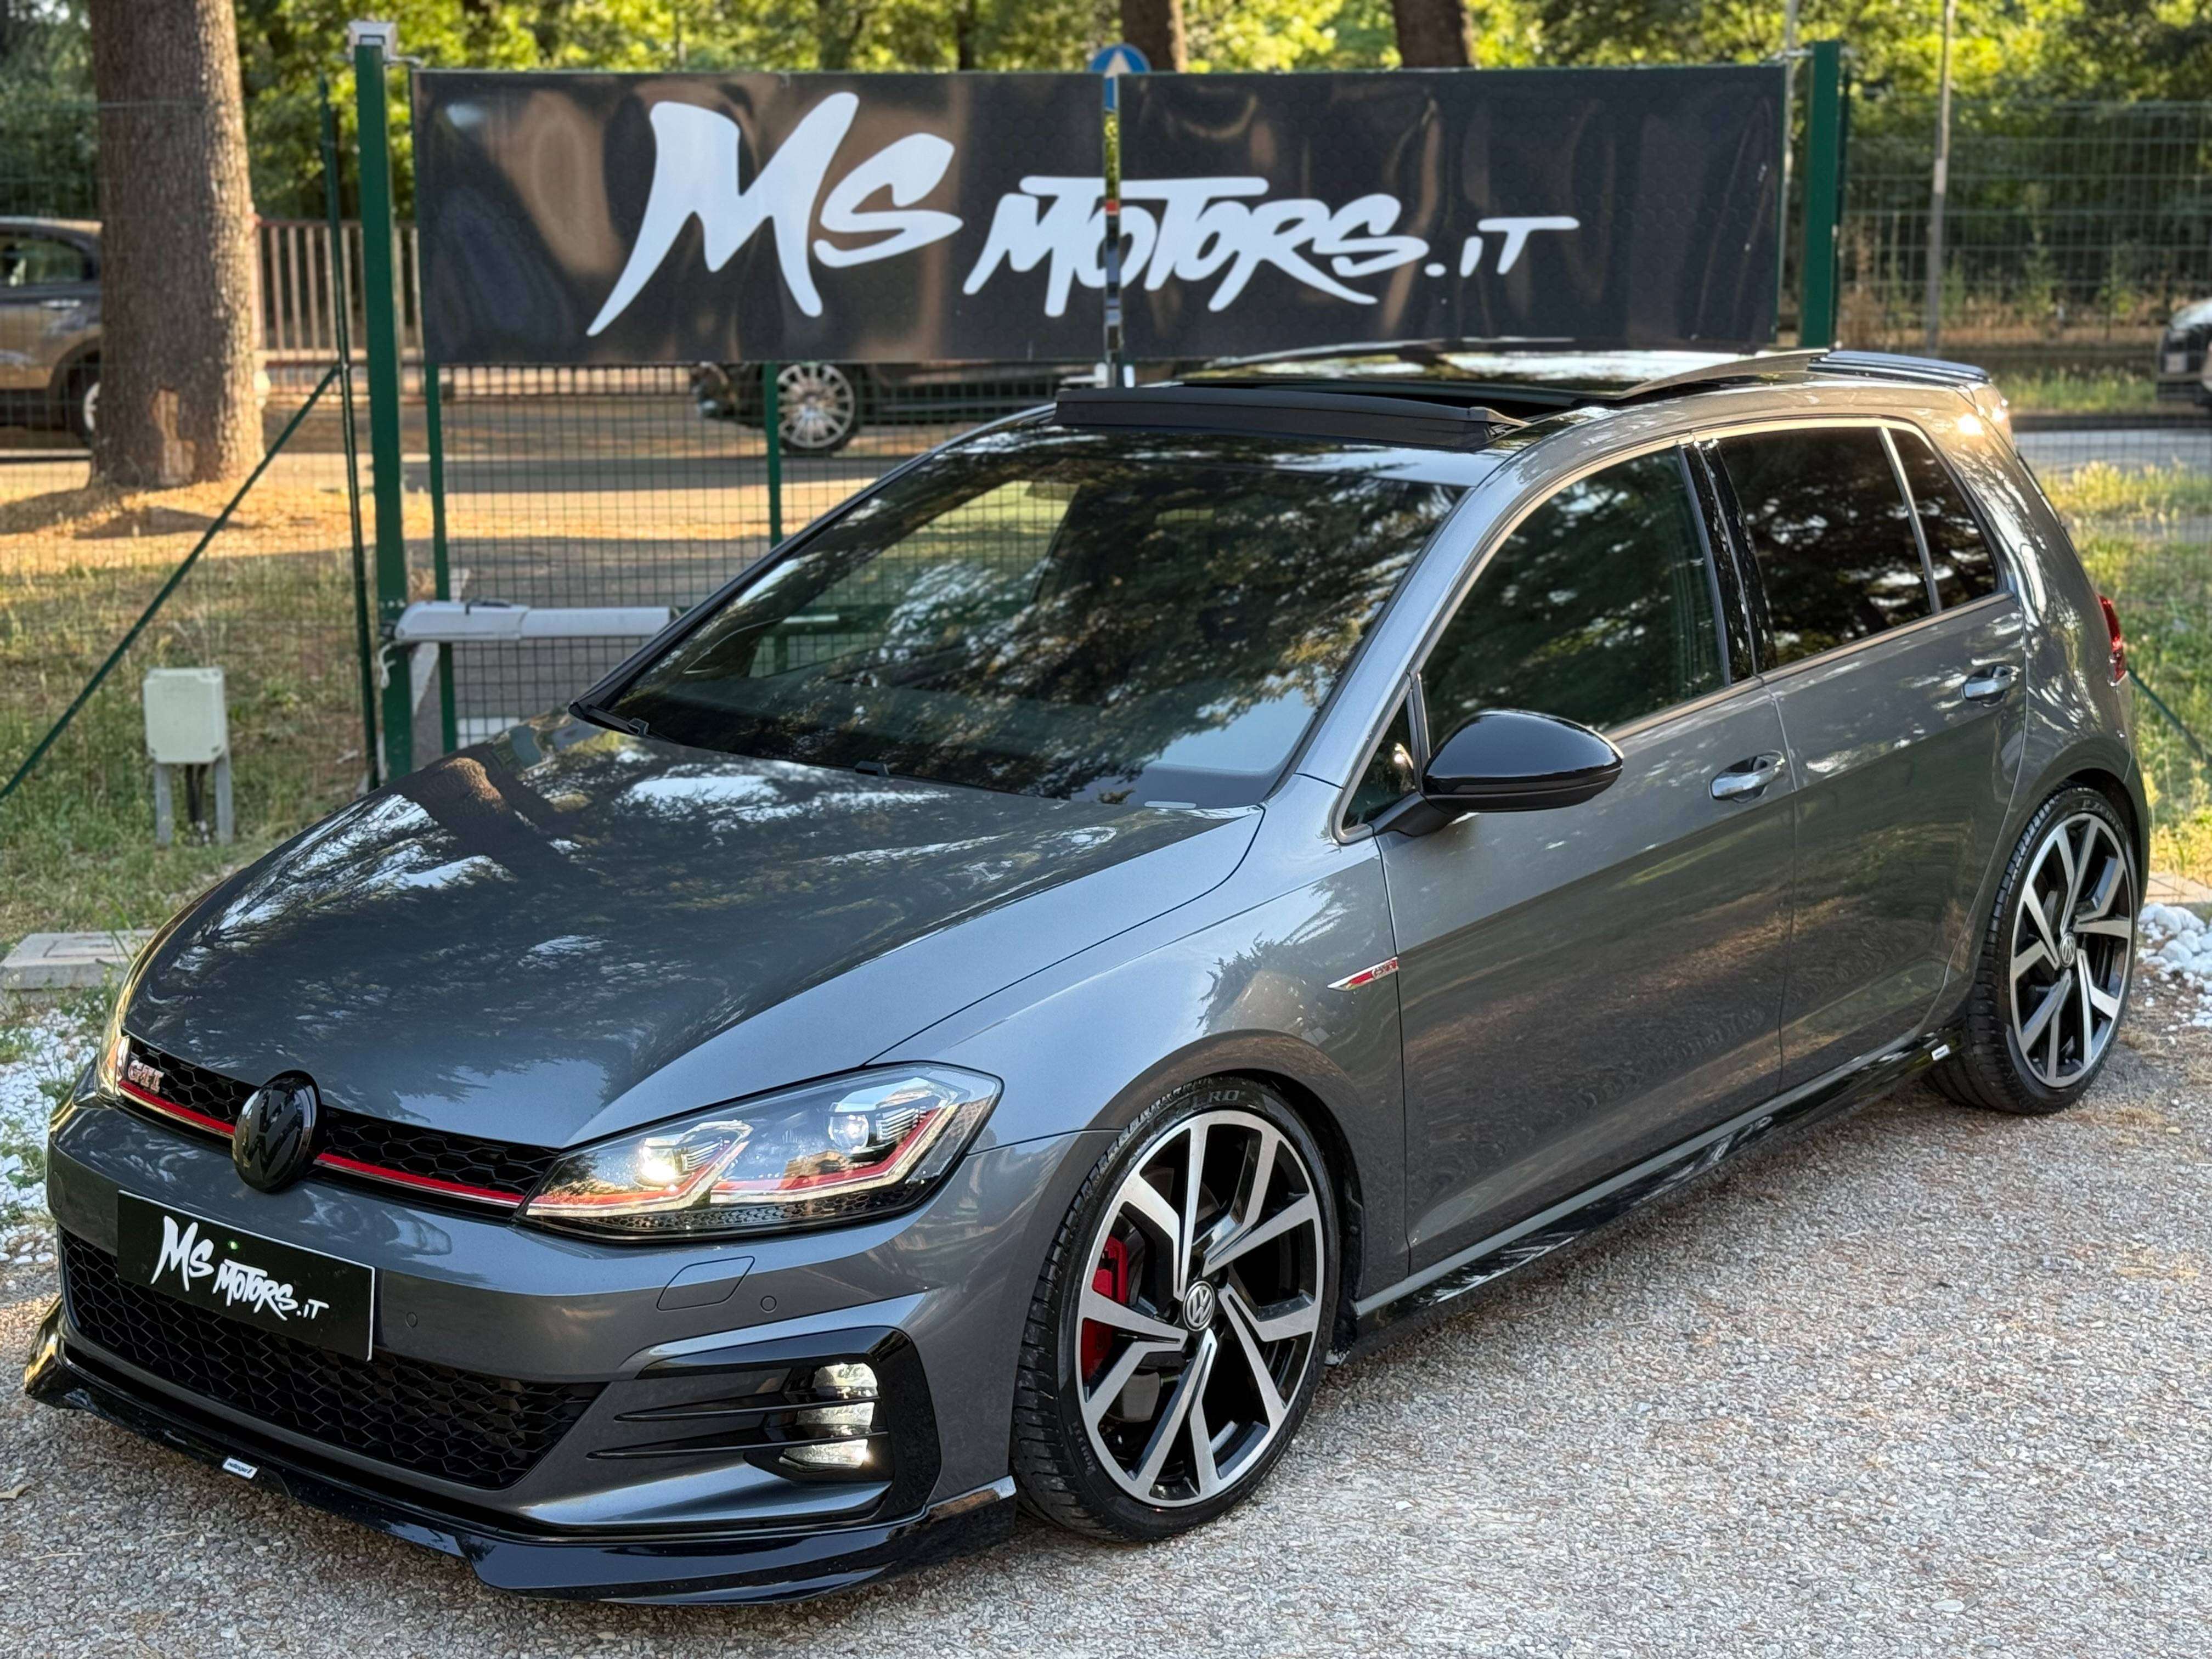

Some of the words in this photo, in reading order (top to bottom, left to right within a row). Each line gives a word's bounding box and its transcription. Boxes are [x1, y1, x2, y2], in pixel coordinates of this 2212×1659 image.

[587, 91, 963, 335] MS
[128, 1059, 165, 1093] GTI
[151, 1215, 215, 1292] MS
